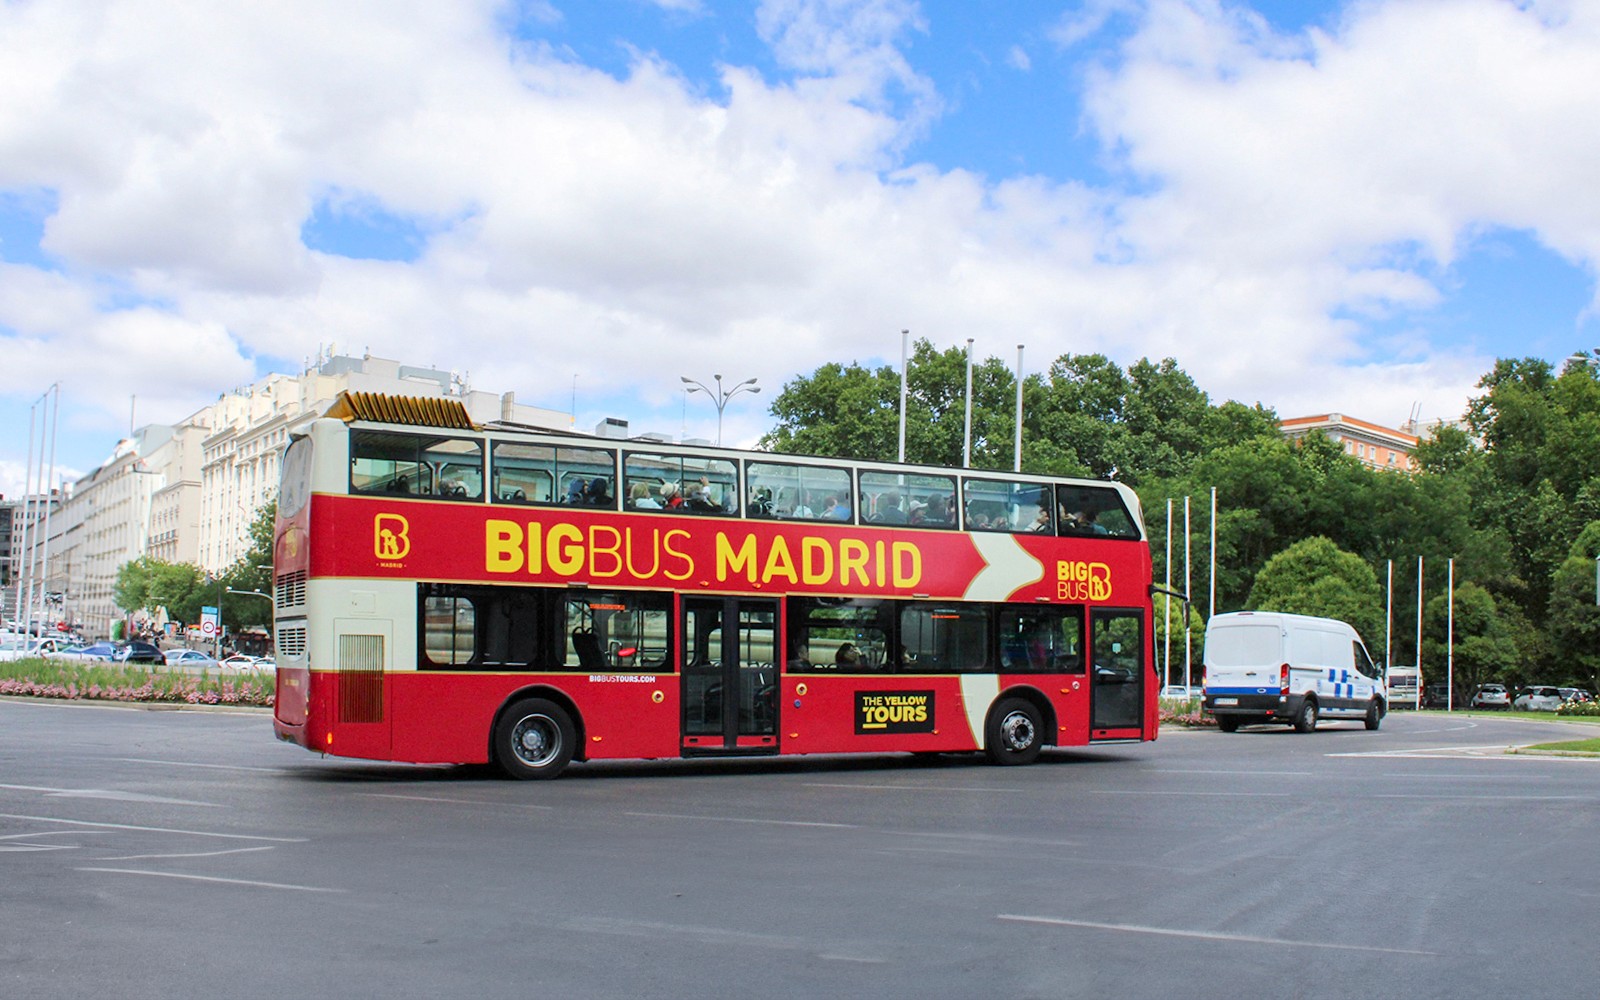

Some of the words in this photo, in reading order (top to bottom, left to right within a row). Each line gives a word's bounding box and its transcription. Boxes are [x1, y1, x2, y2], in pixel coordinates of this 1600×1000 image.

[715, 531, 923, 590] MADRID
[1057, 560, 1088, 582] BIG
[1057, 581, 1089, 601] BUS
[589, 674, 656, 683] BIGBUSTOURS.COM
[863, 696, 883, 706] THE
[884, 695, 927, 706] YELLOW
[862, 705, 928, 723] TOURS
